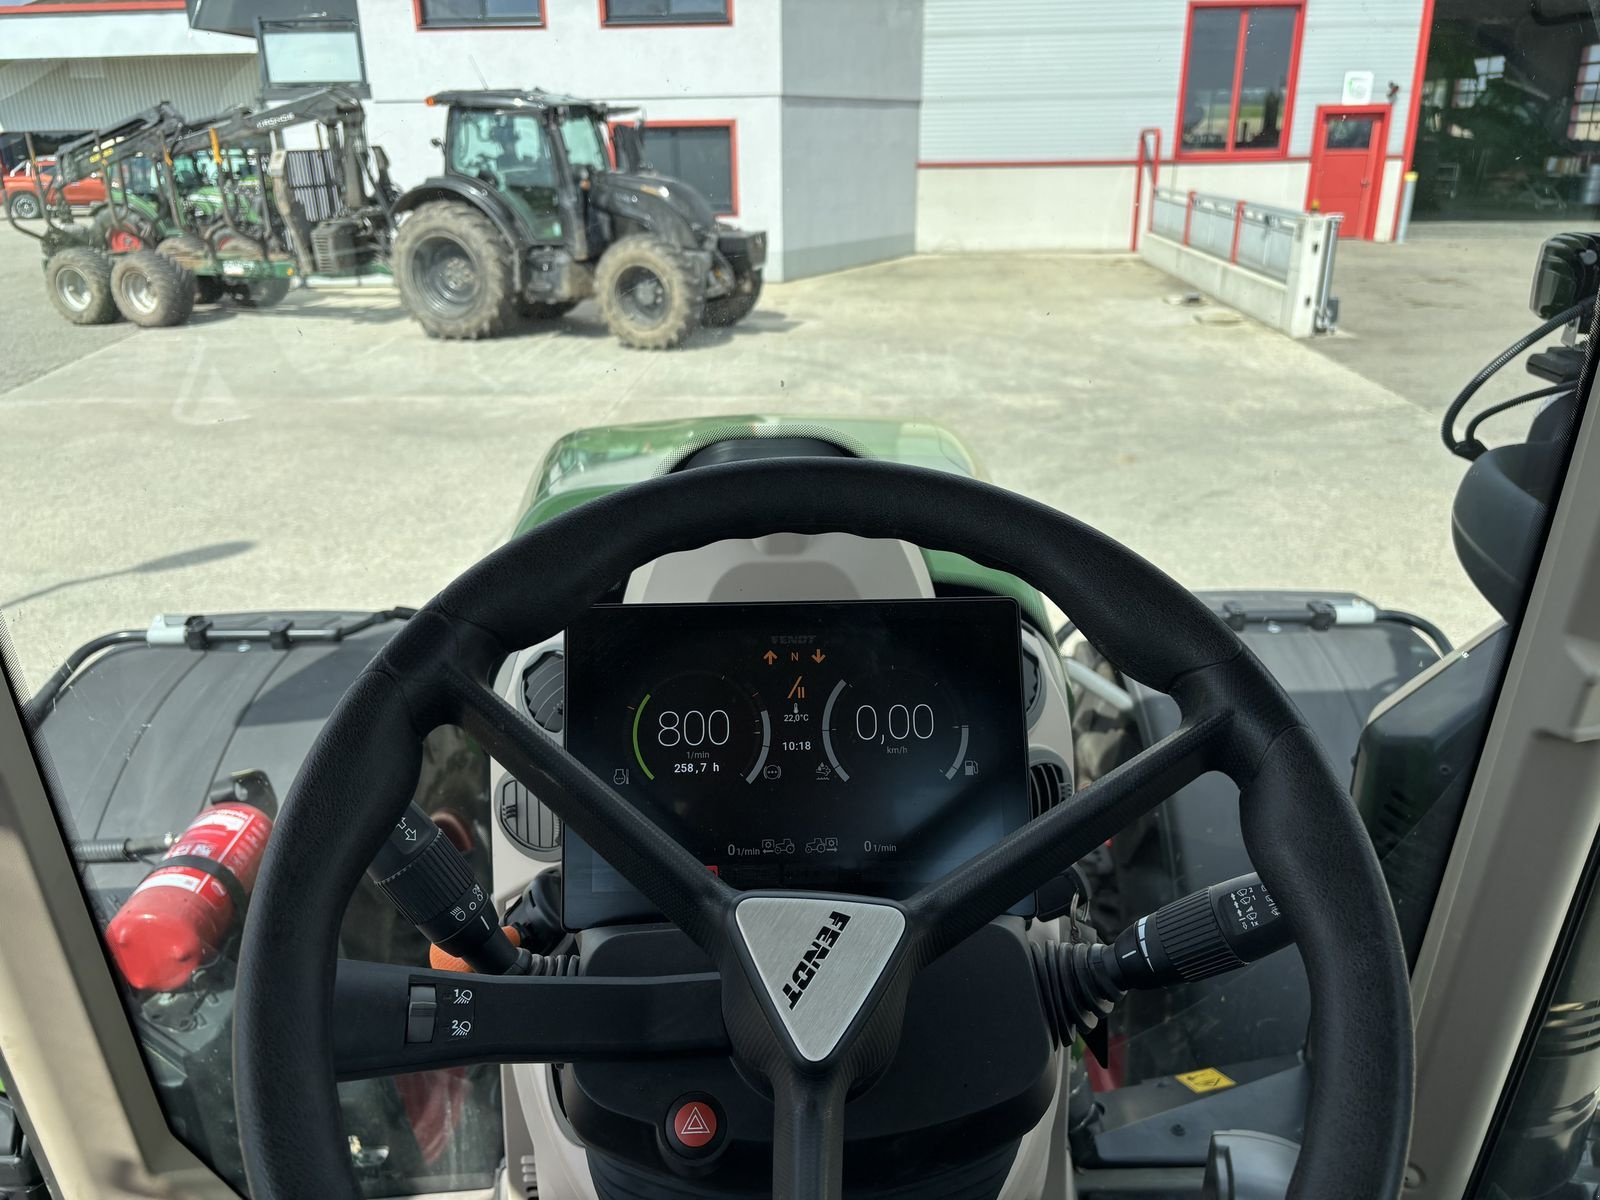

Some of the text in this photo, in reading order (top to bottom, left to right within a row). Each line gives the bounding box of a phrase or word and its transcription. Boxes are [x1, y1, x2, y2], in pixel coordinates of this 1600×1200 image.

[791, 651, 799, 662] N
[783, 714, 809, 723] 22,0°C
[658, 709, 729, 747] 800
[856, 703, 934, 745] 0,00
[782, 741, 812, 751] 10:18
[886, 745, 908, 754] km/h
[686, 751, 710, 760] 1/min
[674, 762, 720, 774] 258,7 h
[737, 847, 761, 856] 1/min
[873, 844, 897, 853] 1/min
[782, 910, 852, 1011] FENDT
[453, 988, 459, 998] 1
[452, 1019, 459, 1029] 2
